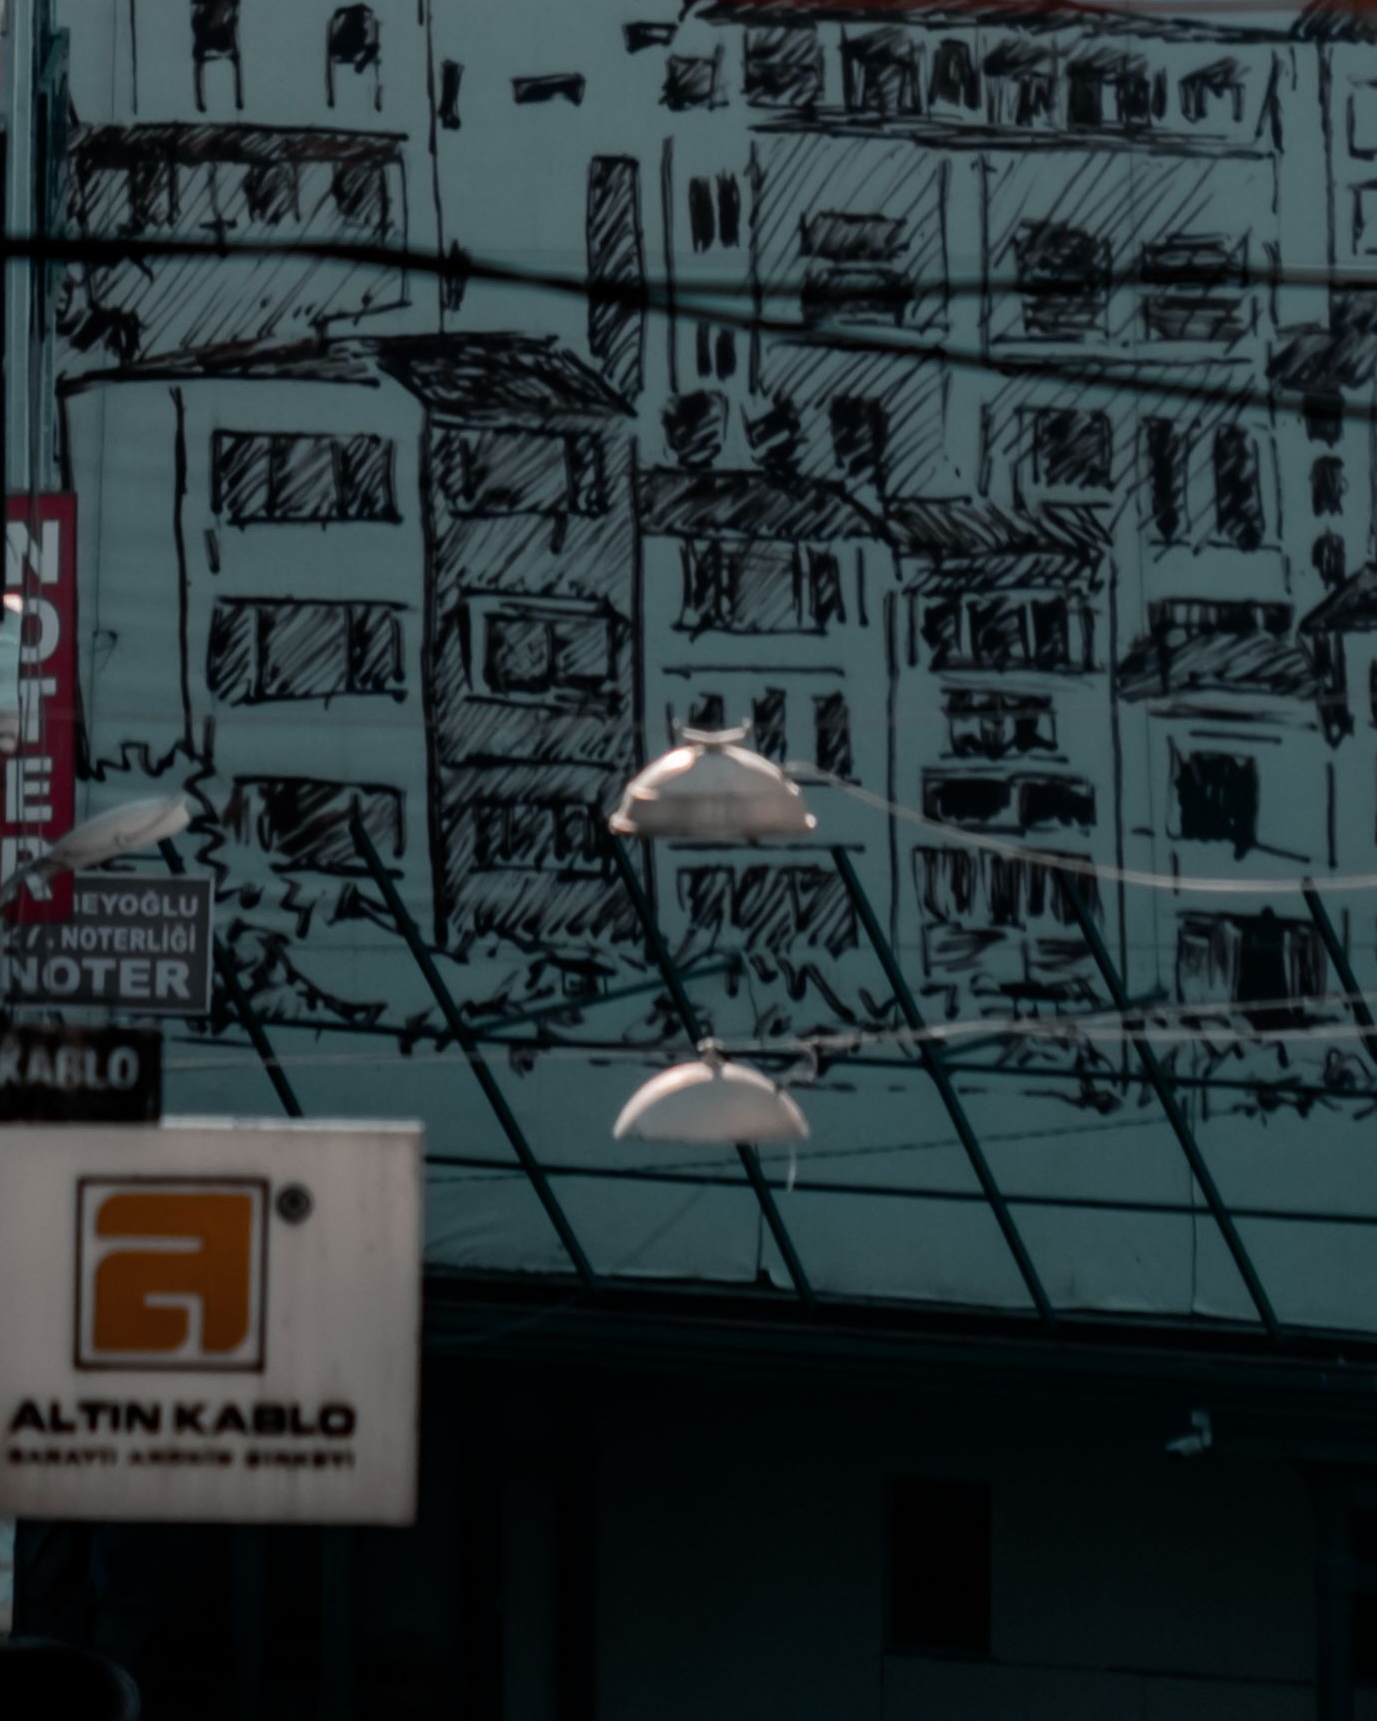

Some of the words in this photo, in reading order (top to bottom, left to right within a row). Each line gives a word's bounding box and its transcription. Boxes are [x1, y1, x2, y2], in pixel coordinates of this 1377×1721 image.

[2, 520, 60, 901] NOTER
[73, 890, 198, 917] EYOĞLU
[60, 923, 196, 954] NOTERLİĞİ
[2, 956, 191, 1000] NOTER
[7, 1400, 161, 1435] ALTIN
[174, 1401, 357, 1437] KABLO
